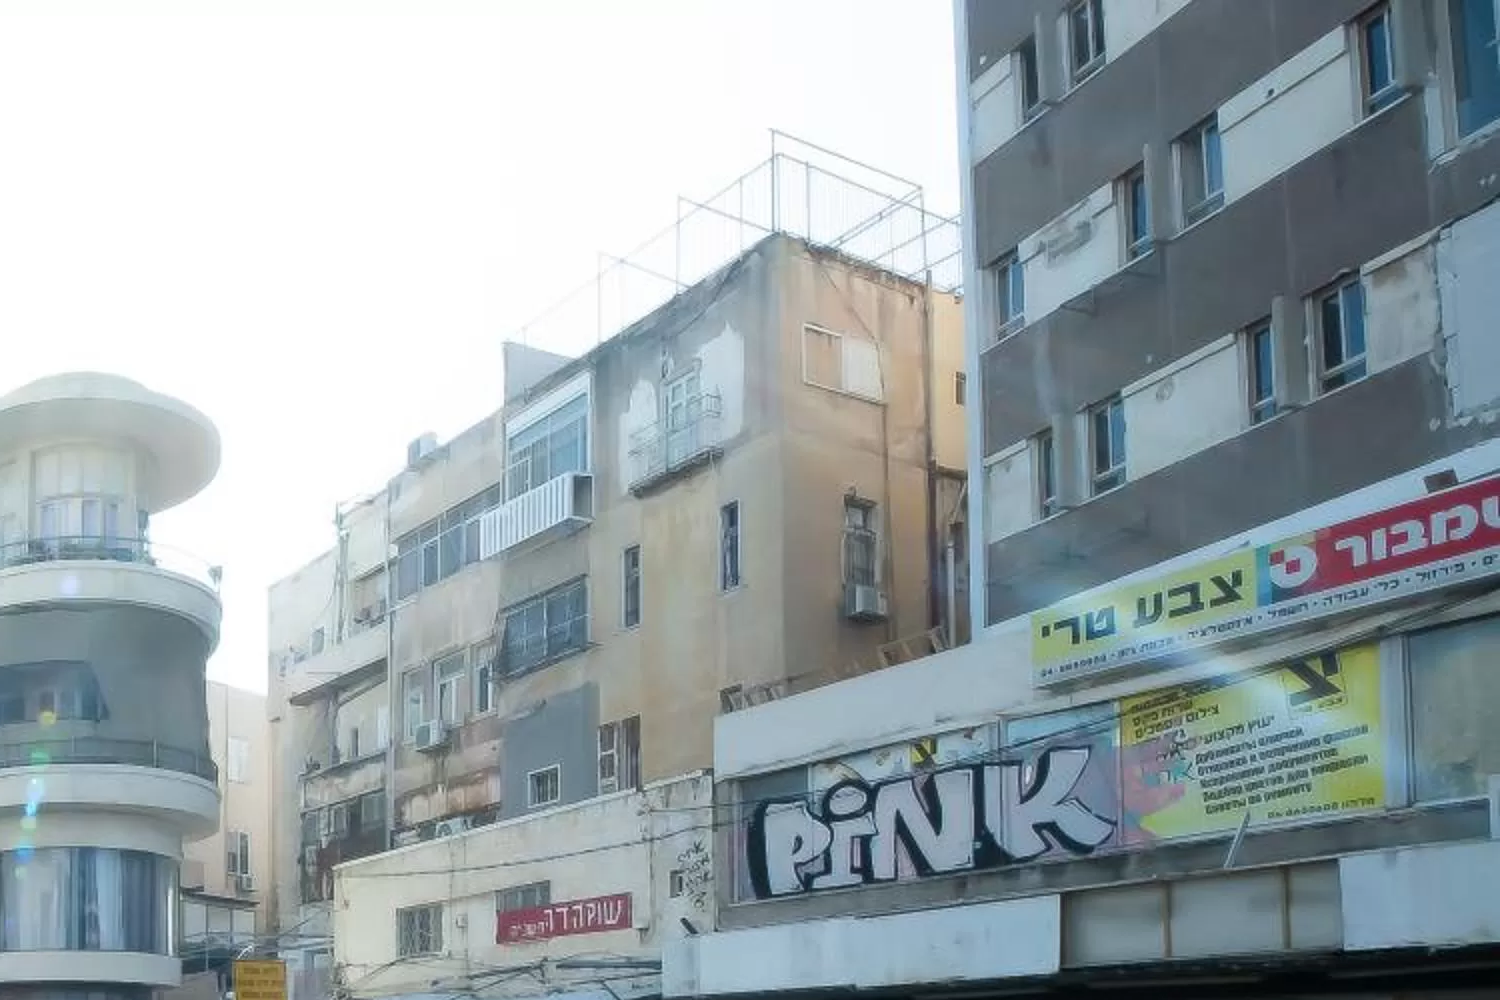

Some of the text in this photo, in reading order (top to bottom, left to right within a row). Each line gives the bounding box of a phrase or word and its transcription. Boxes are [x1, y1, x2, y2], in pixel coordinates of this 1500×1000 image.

[1041, 568, 1243, 645] צבע טרי
[1322, 586, 1369, 607] עבודה
